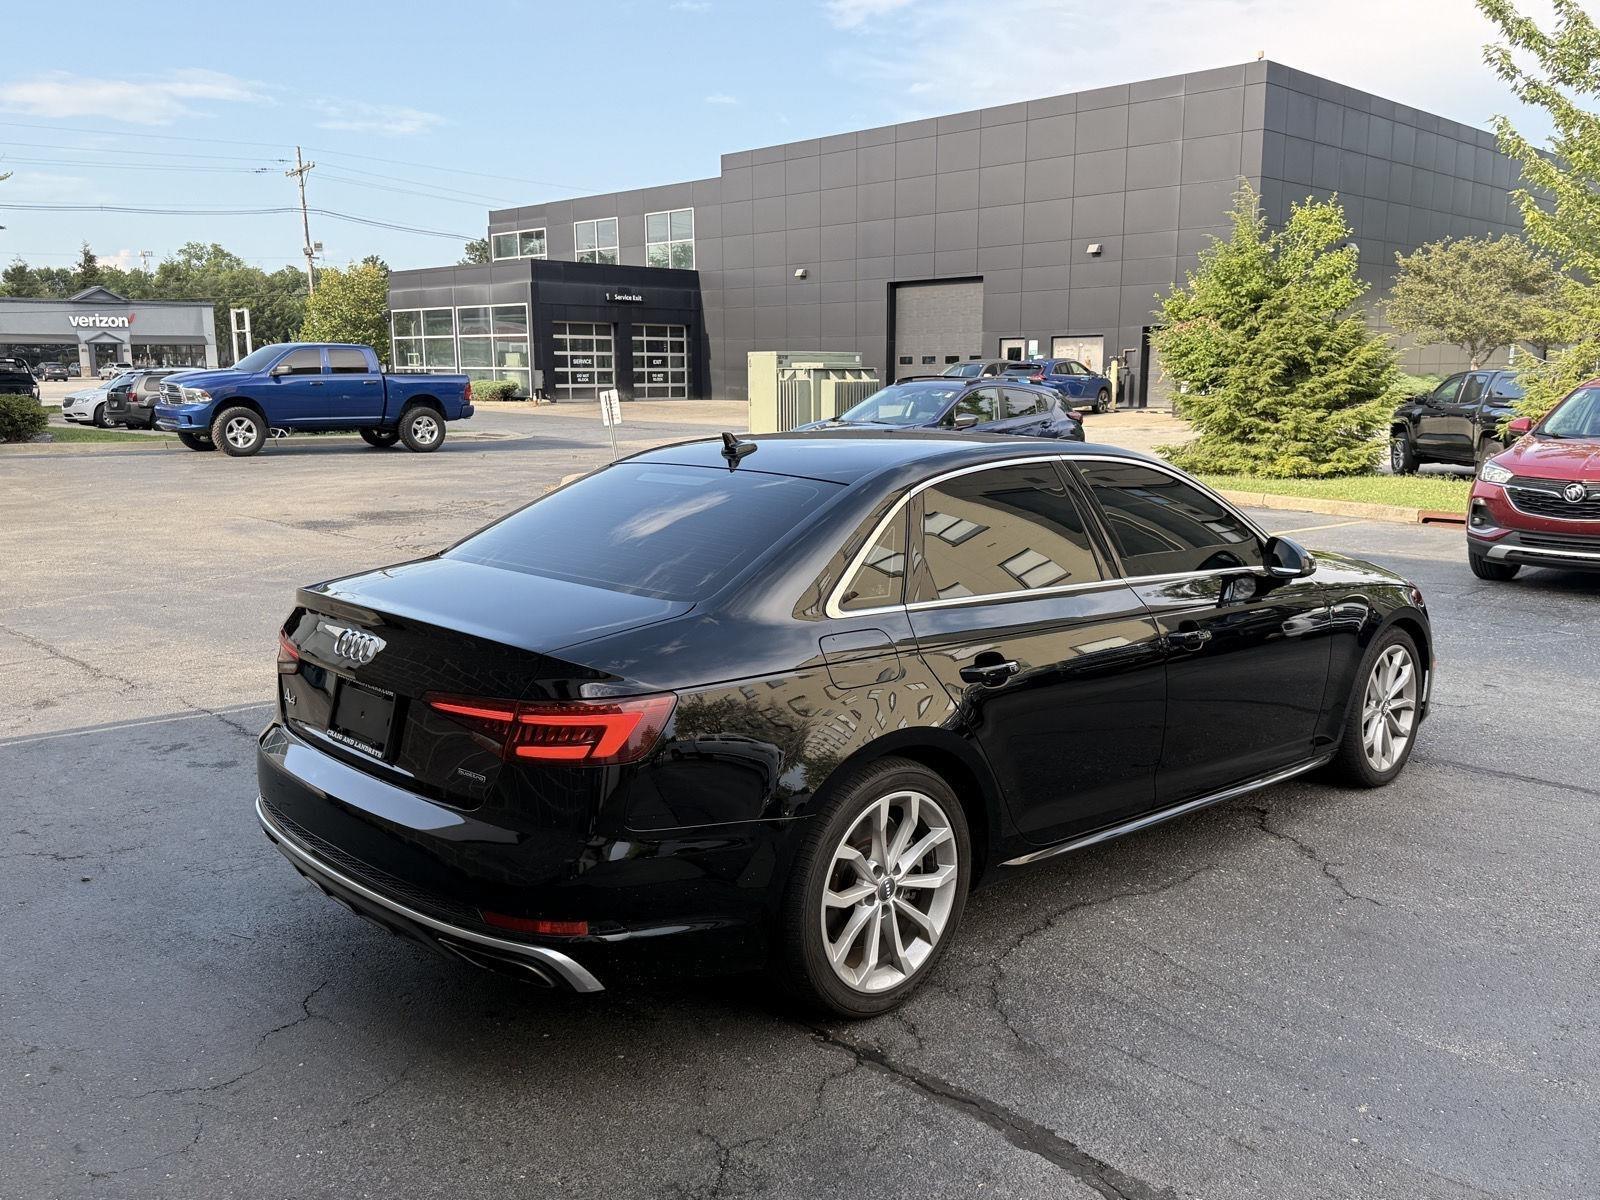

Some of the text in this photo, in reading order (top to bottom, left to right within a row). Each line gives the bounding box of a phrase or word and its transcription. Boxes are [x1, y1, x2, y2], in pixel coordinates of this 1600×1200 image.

[68, 313, 129, 328] verizon
[284, 688, 296, 706] A4
[326, 729, 384, 759] CRAIG AND LANDRETH
